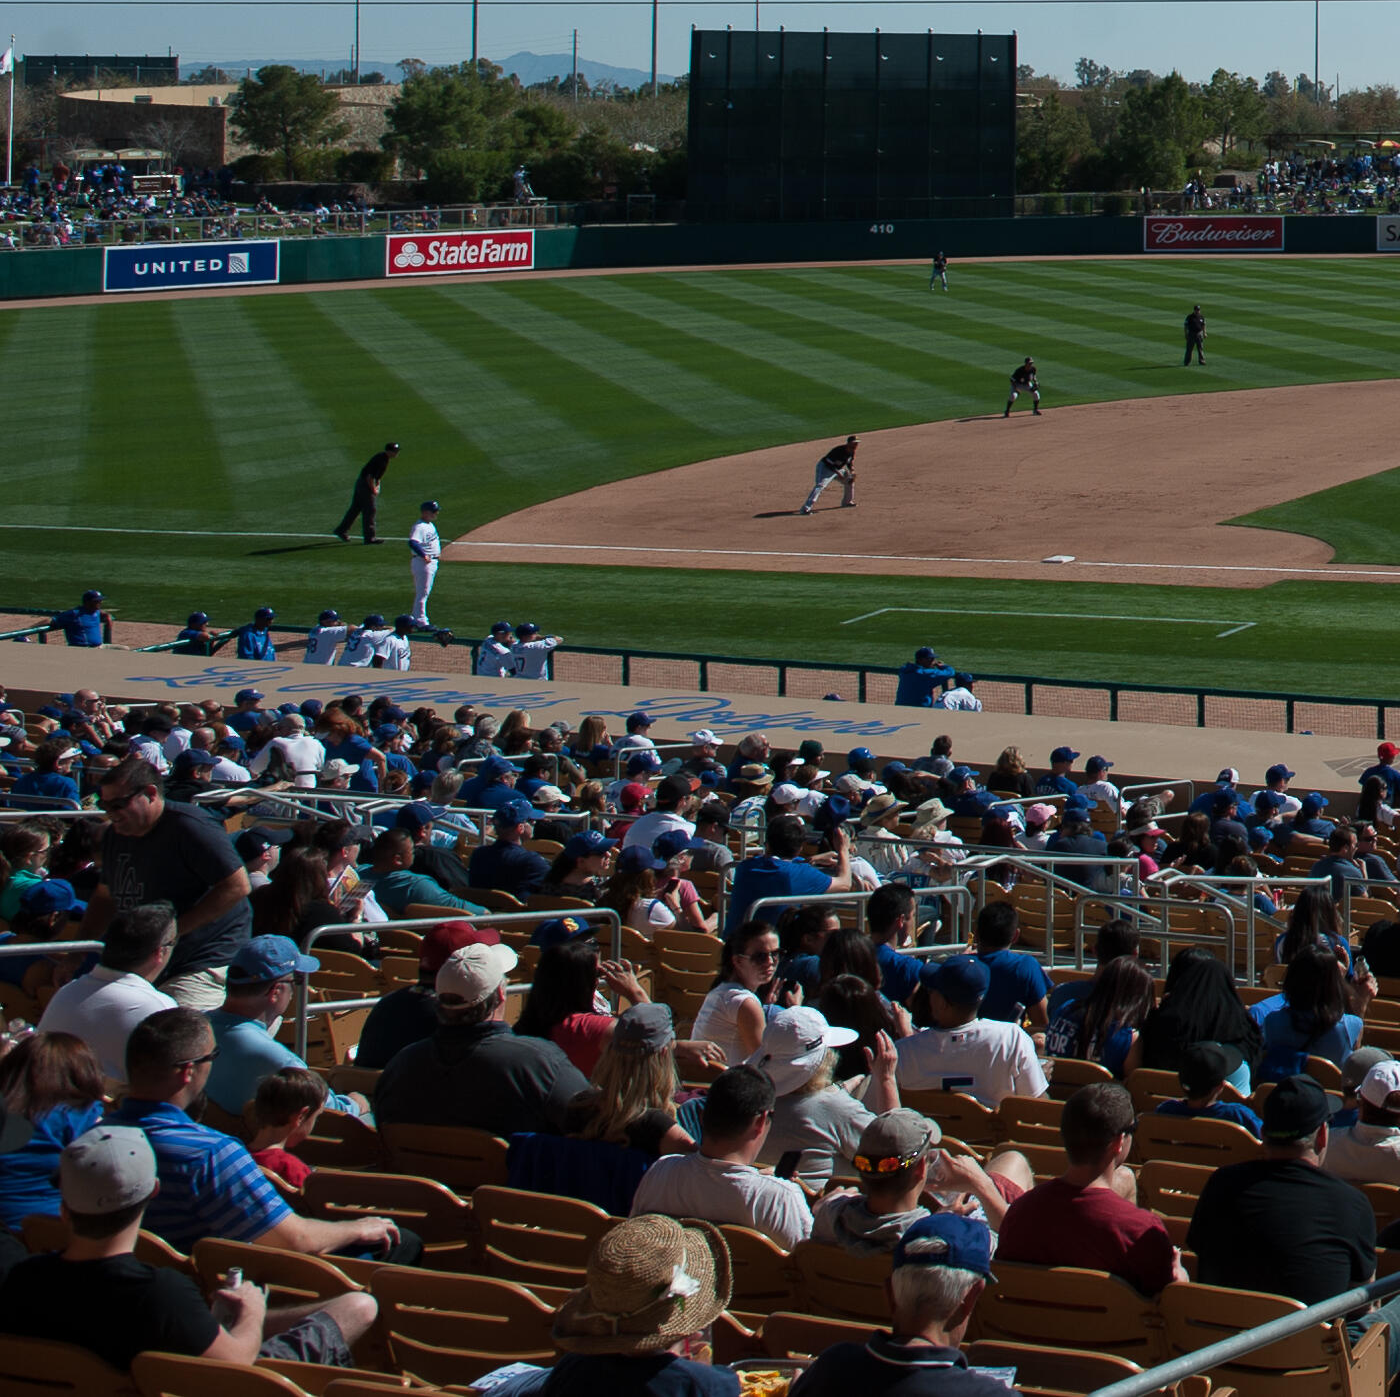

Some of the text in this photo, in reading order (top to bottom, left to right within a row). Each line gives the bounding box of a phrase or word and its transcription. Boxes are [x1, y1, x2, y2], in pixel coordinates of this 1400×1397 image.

[869, 224, 894, 234] 410
[1151, 222, 1276, 244] Budweiser
[134, 258, 223, 275] UNITED
[578, 695, 921, 737] Dodgers
